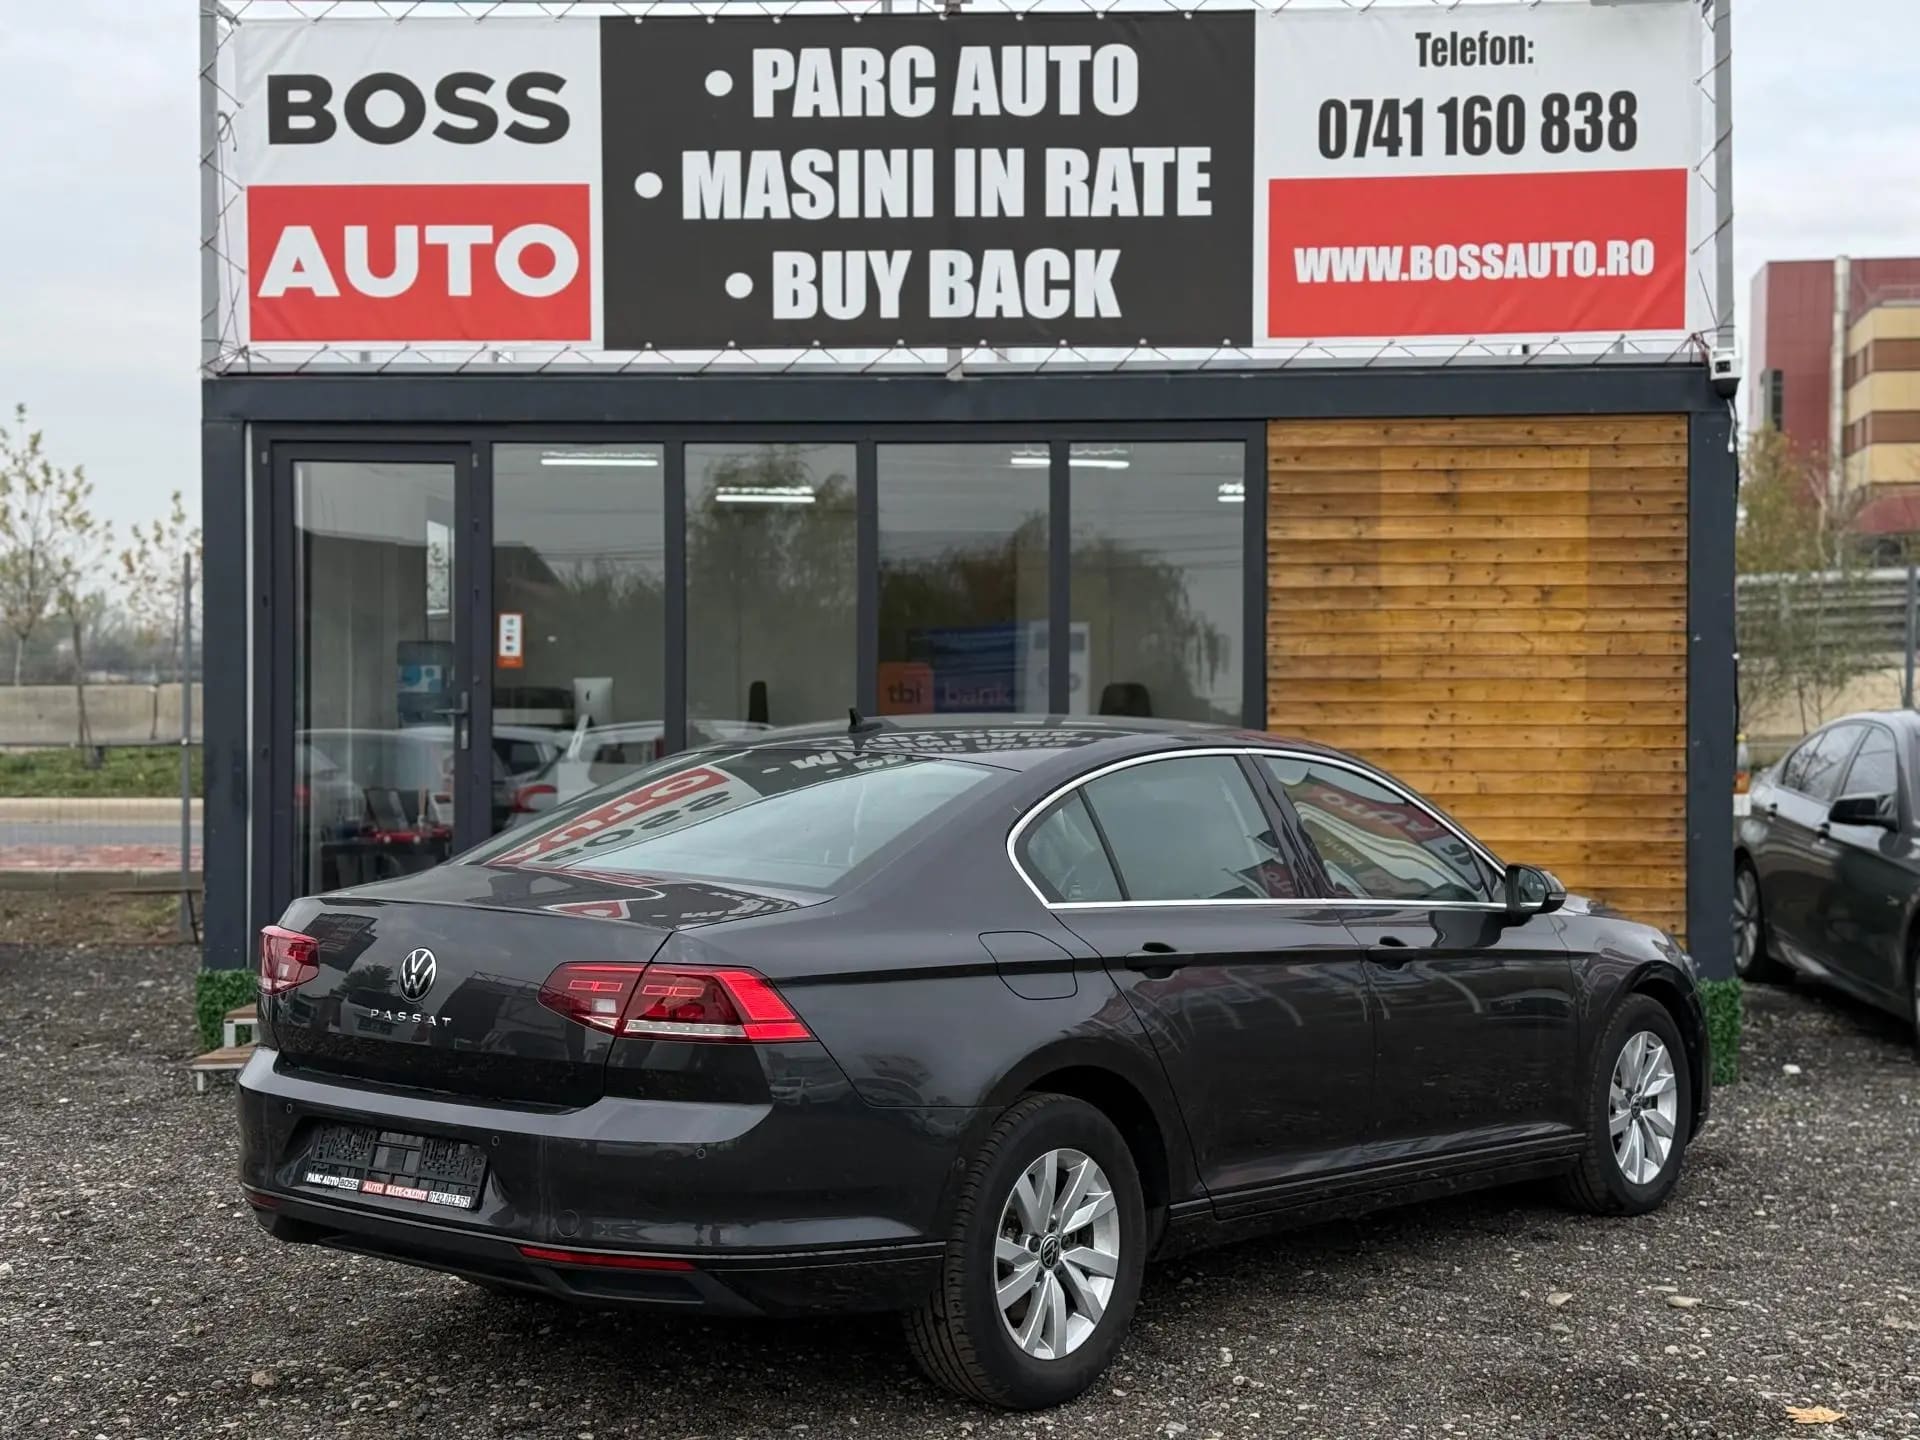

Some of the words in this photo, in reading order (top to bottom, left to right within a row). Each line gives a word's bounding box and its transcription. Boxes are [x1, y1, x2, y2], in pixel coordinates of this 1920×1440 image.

[753, 46, 936, 118] PARC
[952, 44, 1139, 117] AUTO
[1416, 31, 1534, 67] Telefon:
[267, 72, 571, 145] BOSS
[1319, 97, 1424, 159] 0741
[1438, 95, 1526, 156] 160
[1541, 91, 1638, 153] 838
[682, 149, 934, 220] MASINI
[955, 148, 1025, 217] IN
[1045, 147, 1212, 217] RATE
[257, 223, 579, 298] AUTO
[772, 250, 912, 321] BUY
[930, 248, 1122, 319] BACK
[1294, 239, 1655, 284] WWW.BOSSAUTO.RO
[888, 681, 923, 704] tbi
[944, 681, 1012, 705] bank
[369, 1009, 452, 1028] PASSAT
